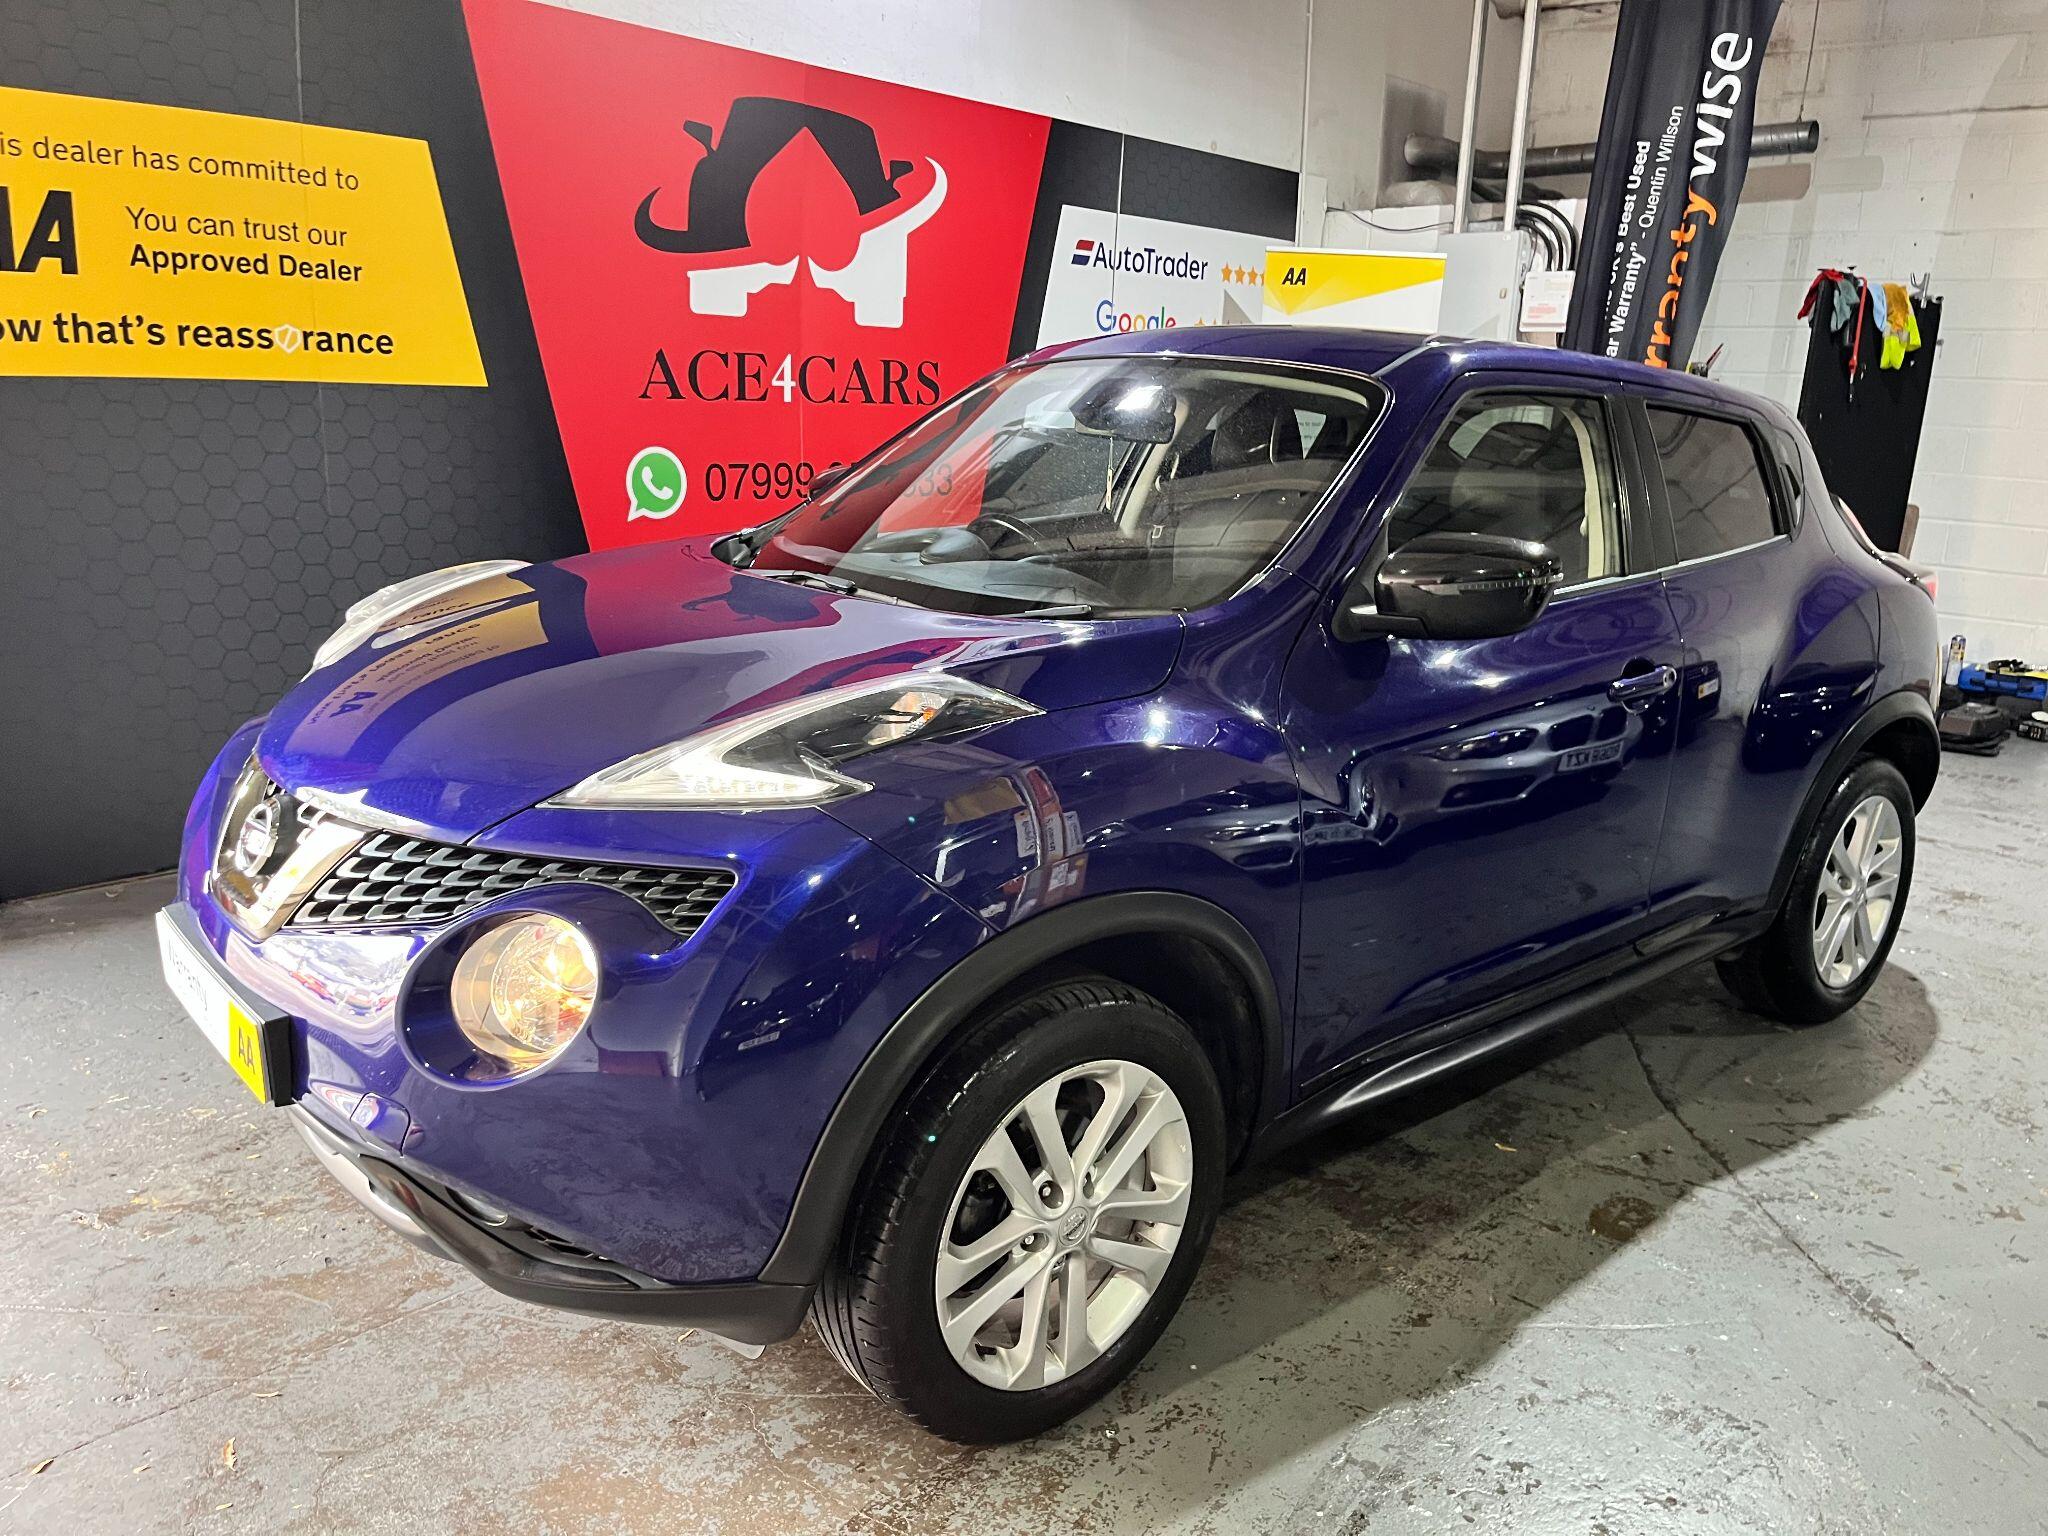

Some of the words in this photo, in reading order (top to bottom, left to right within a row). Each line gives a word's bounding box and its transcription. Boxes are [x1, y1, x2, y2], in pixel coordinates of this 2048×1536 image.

[33, 136, 124, 166] dealer
[132, 144, 179, 172] has
[189, 156, 327, 188] committed
[335, 168, 359, 191] to
[1626, 141, 1651, 189] Used
[1638, 166, 1668, 228] Quentin
[1655, 105, 1684, 163] Willson
[125, 205, 177, 233] You
[187, 216, 234, 238] can
[243, 217, 300, 243] trust
[307, 227, 347, 247] our
[1617, 193, 1637, 237] Best
[130, 243, 269, 276] Approved
[279, 254, 362, 282] Dealer
[1093, 241, 1209, 280] AutoTrader
[1282, 267, 1307, 286] AA
[0, 318, 42, 342] w
[53, 312, 166, 346] that's
[638, 347, 941, 407] ACE4CARS
[705, 461, 815, 502] 07999
[238, 1026, 255, 1075] AA
